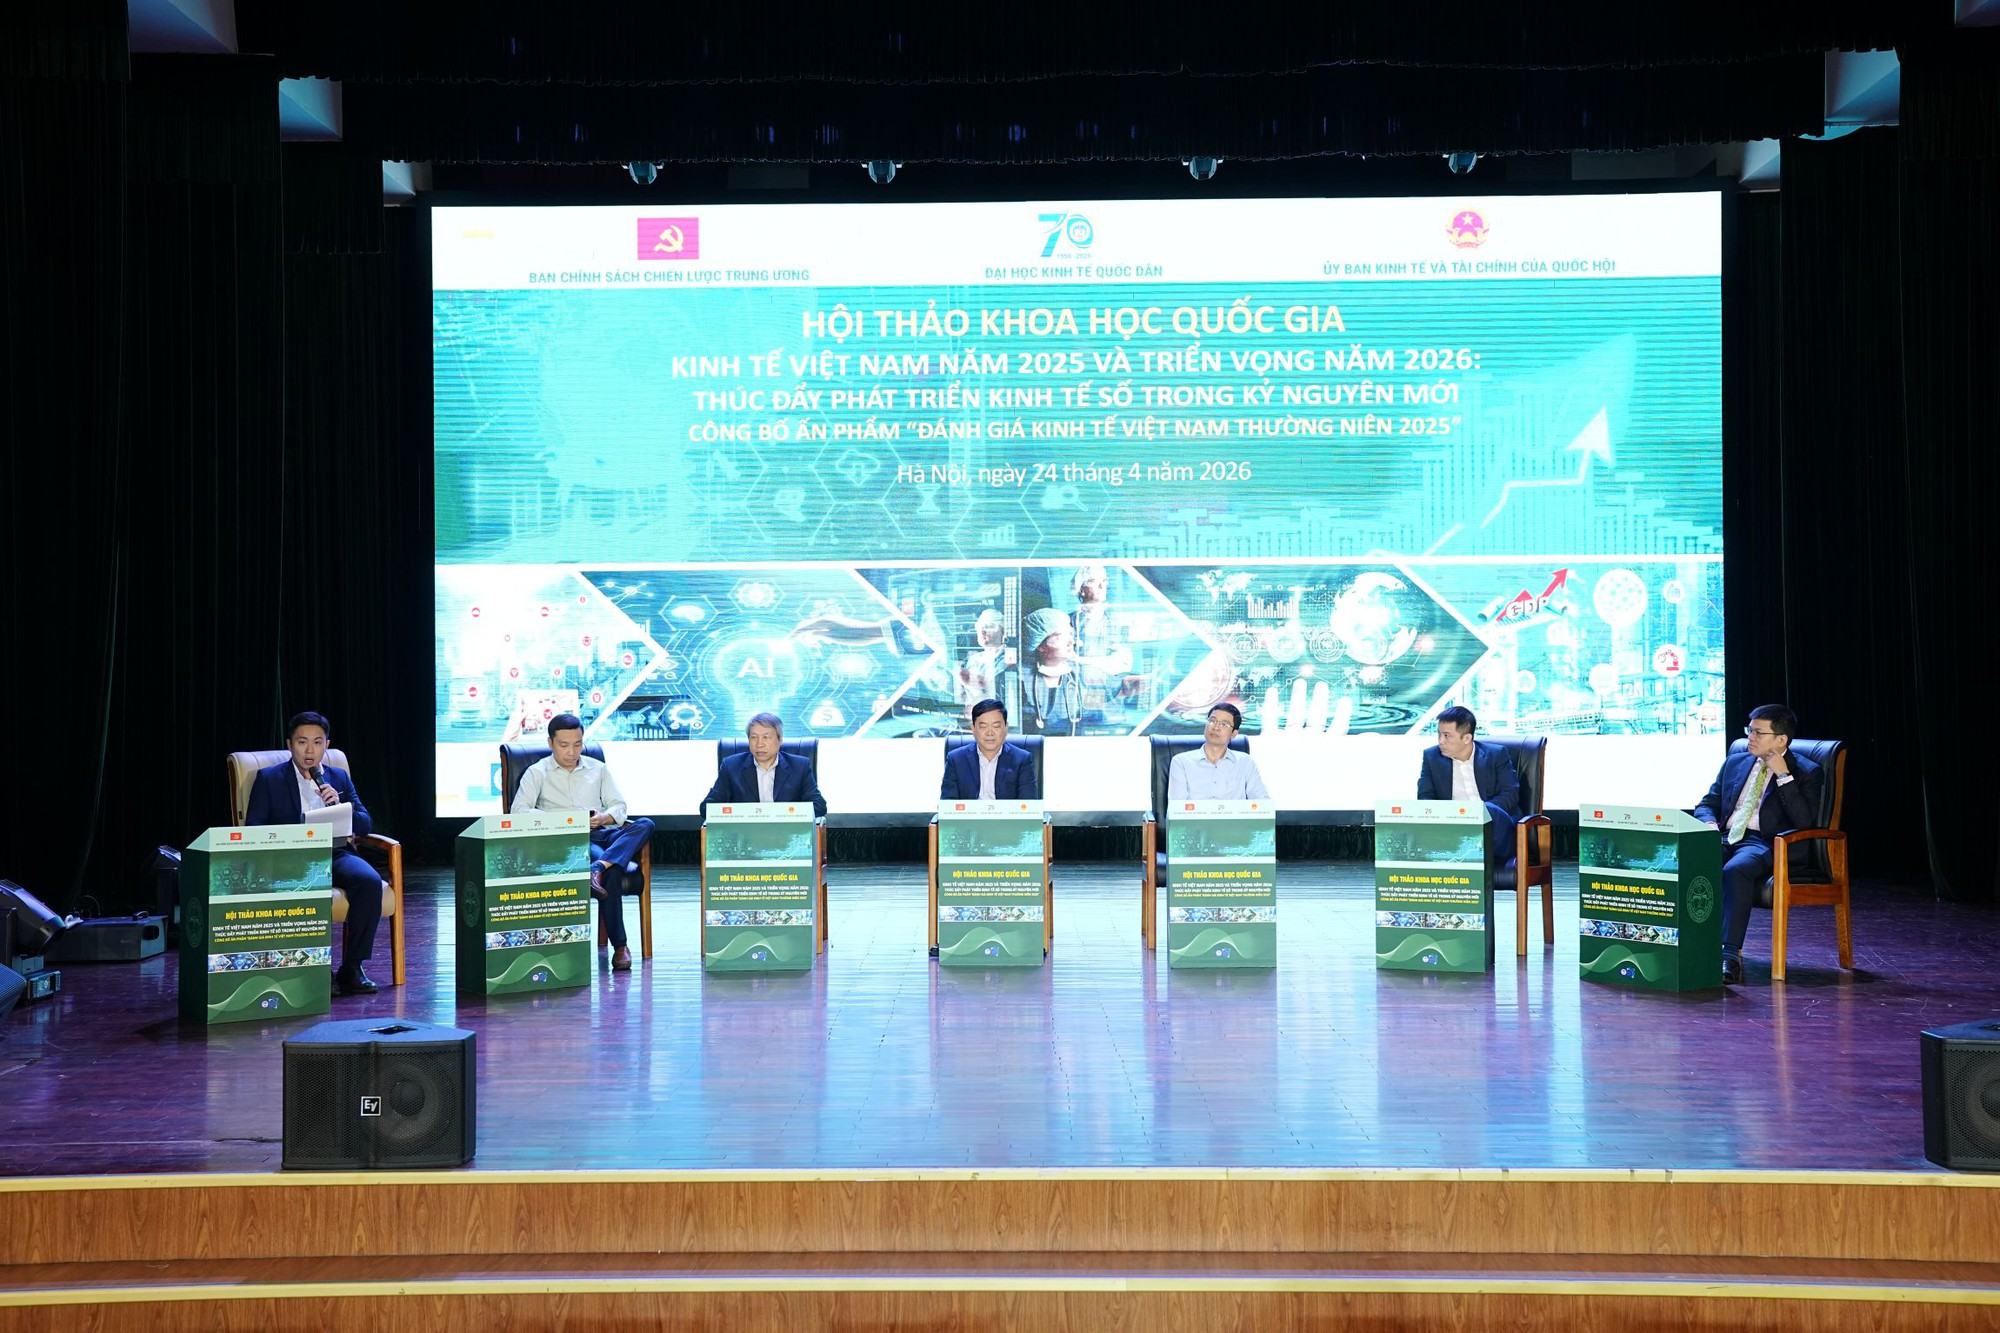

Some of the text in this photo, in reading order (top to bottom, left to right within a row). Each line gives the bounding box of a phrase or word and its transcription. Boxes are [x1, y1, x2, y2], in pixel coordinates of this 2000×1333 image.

[529, 266, 810, 284] BAN CHÍNH SÁCH CHIẾN LƯỢC TRUNG ƯƠNG
[986, 262, 1162, 280] ĐẠI HỌC KINH TẾ QUỐC DÂN
[1324, 256, 1616, 275] ỦY BAN KINH TẾ VÀ TÀI CHÍNH CỦA QUỐC HỘI
[803, 296, 1345, 344] HỘI THẢO KHOA HỌC QUỐC GIA
[672, 342, 1481, 381] KINH TẾ VIỆT NAM NĂM 2025 VÀ TRIỂN VỌNG NĂM 2026:
[693, 378, 1459, 412] THÚC ĐẨY PHÁT TRIỂN KINH TẾ SỐ TRONG KỶ NGUYÊN MỚI
[688, 413, 1461, 442] CÔNG BỐ ẤN PHẨM “ĐÁNH GIÁ KINH TẾ VIỆT NAM THƯỜNG NIÊN 2025”
[898, 461, 1251, 487] Hà Nội, ngày 24 tháng 4 năm 2026
[737, 658, 776, 678] AI
[226, 911, 236, 920] HỘI
[238, 909, 254, 919] THẢO
[256, 910, 272, 918] KHOA
[274, 910, 286, 918] HỌC
[288, 907, 304, 917] QUỐC
